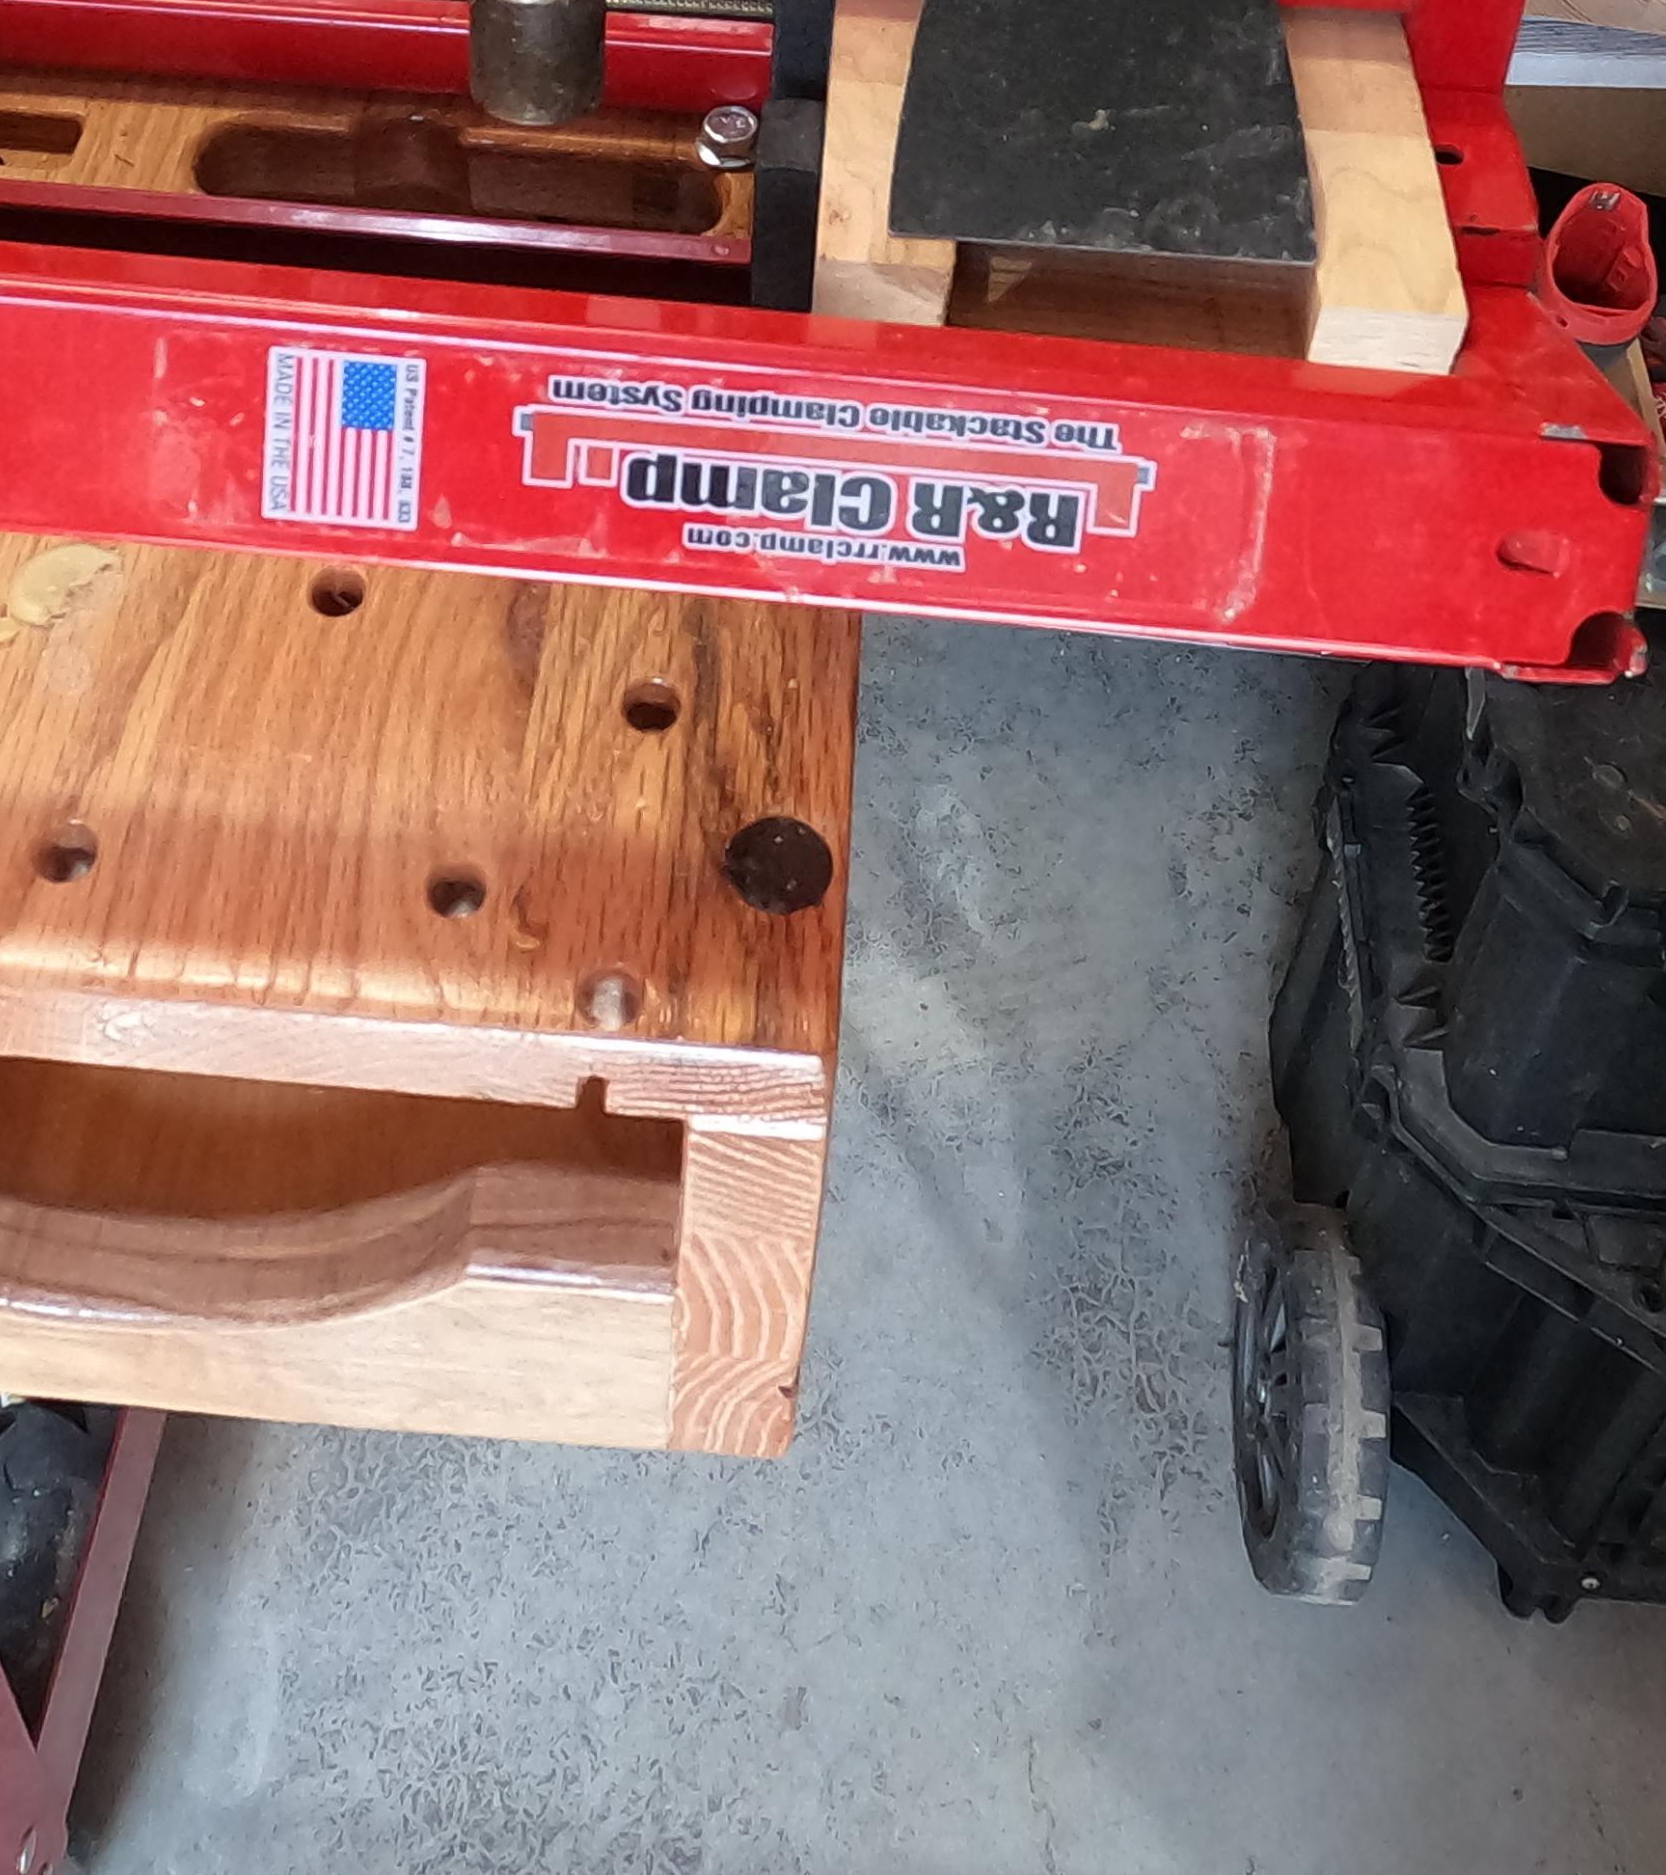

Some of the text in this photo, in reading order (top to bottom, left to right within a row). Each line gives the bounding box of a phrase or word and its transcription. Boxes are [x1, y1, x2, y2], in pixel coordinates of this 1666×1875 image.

[269, 353, 296, 511] MADE IN THE USA
[551, 377, 1120, 450] The Stackable Clamping System
[627, 451, 1082, 550] R&R Clamp
[686, 526, 964, 568] www.rrclamp.com
